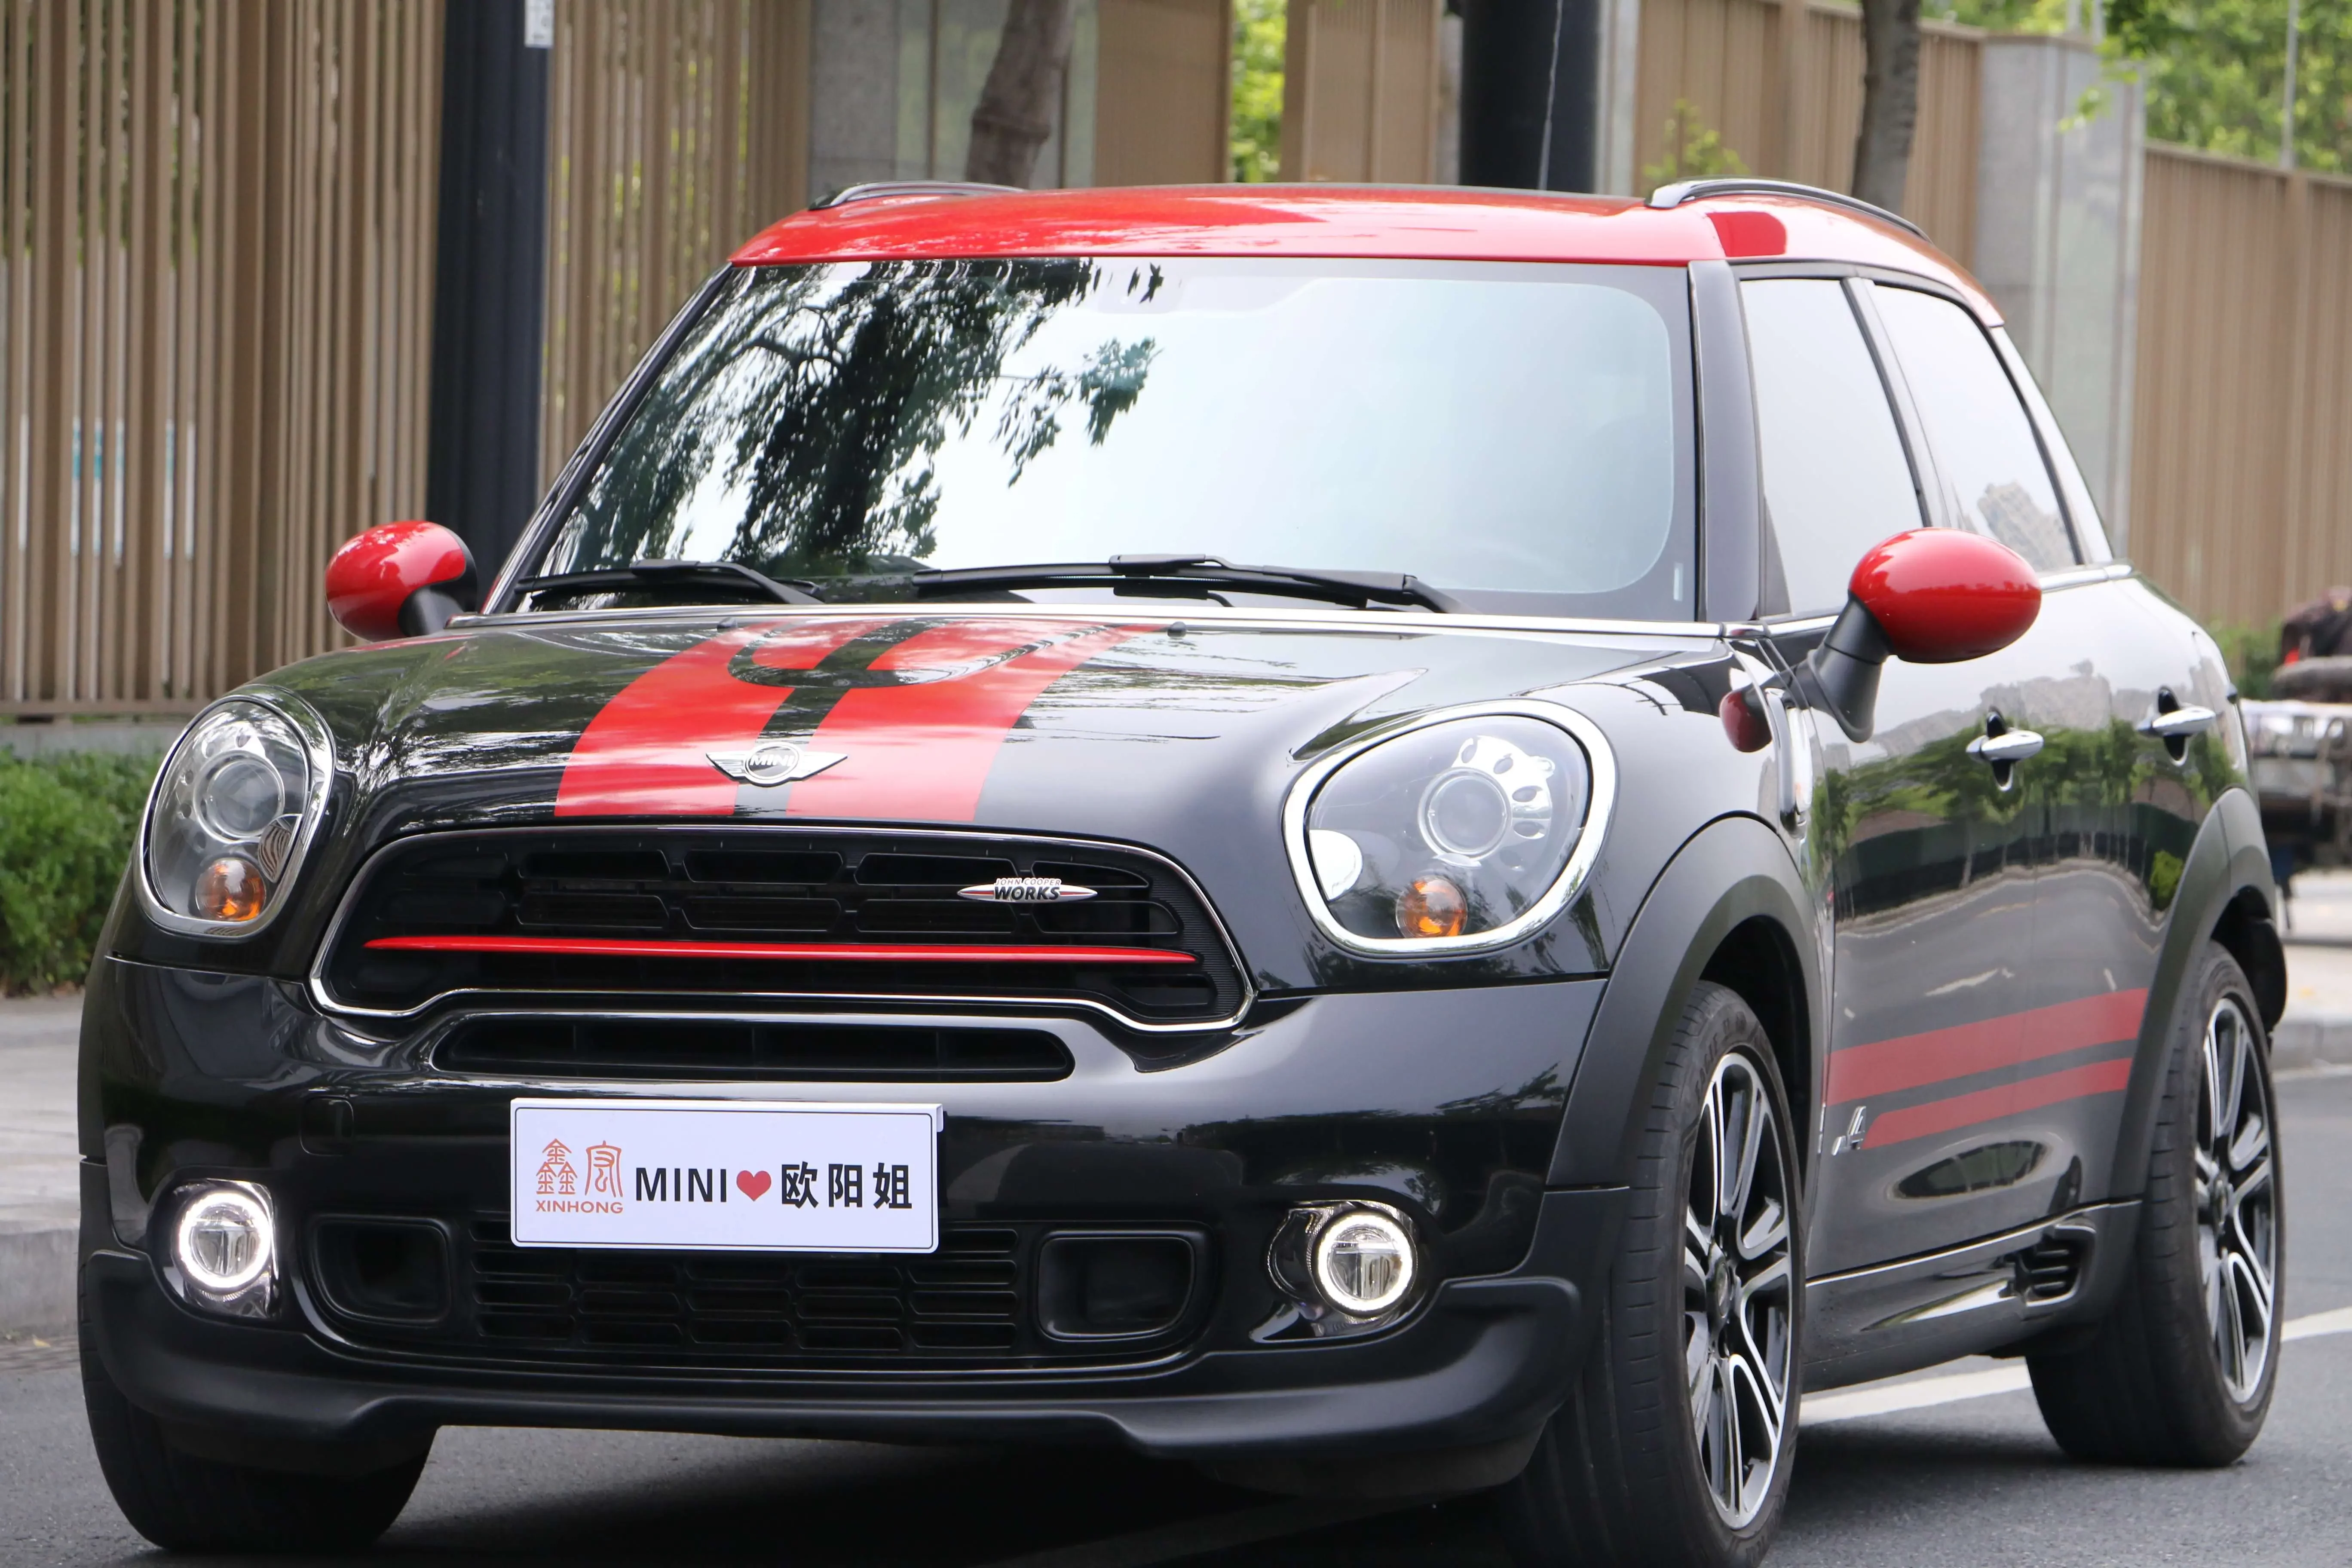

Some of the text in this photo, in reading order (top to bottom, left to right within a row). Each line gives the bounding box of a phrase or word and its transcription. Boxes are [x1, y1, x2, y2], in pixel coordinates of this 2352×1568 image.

[749, 754, 795, 767] MINI
[995, 886, 1060, 900] WORKS
[636, 1161, 913, 1210] MINI 欧阳姐
[536, 1200, 624, 1214] XINHONG
